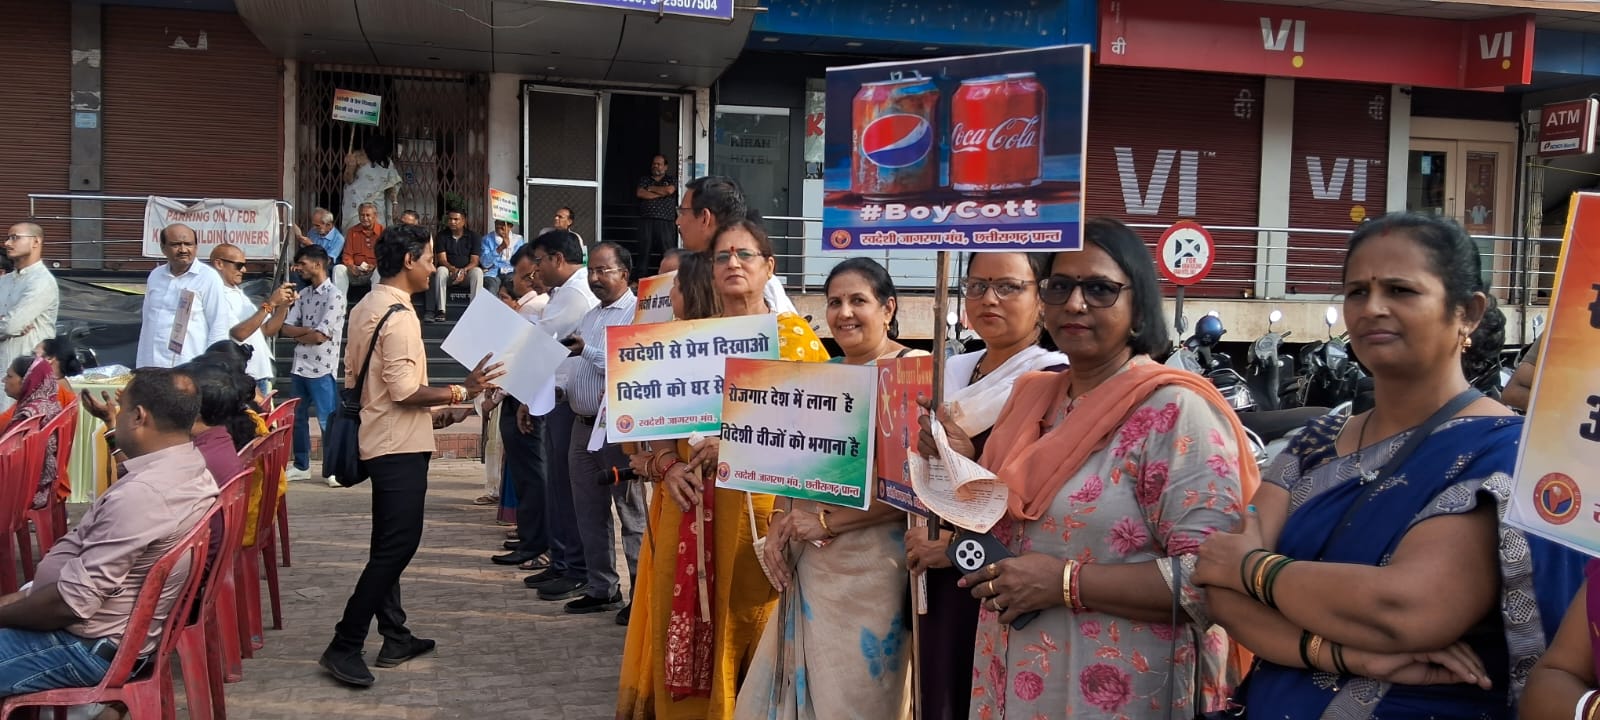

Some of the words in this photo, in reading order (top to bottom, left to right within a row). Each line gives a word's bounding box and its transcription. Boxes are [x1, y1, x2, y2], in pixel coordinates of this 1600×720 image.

[1546, 109, 1580, 127] ATM
[237, 210, 256, 223] FOR
[860, 200, 1038, 223] #BoyCott
[229, 230, 270, 245] OWNERS
[861, 231, 896, 244] स्वदेशी
[898, 231, 942, 244] जागरण
[1031, 229, 1061, 242] प्रान्त
[618, 341, 664, 362] स्वदेशी
[669, 340, 682, 359] से
[686, 338, 708, 358] प्रेम
[714, 332, 770, 356] दिखाओ
[617, 379, 662, 400] विदेशी
[666, 378, 686, 398] को
[691, 379, 710, 396] घर
[729, 383, 768, 405] रोजगार
[770, 386, 790, 407] देश
[793, 388, 804, 408] में
[806, 393, 838, 412] लाना
[842, 392, 854, 413] है
[638, 415, 664, 427] स्वदेशी
[667, 414, 698, 426] जागरण
[720, 422, 754, 444] विदेशी
[756, 426, 788, 448] चीजों
[789, 430, 806, 450] को
[808, 437, 847, 456] भगाना
[848, 436, 860, 458] है
[734, 470, 756, 480] स्वदेशी
[758, 474, 784, 486] जागरण
